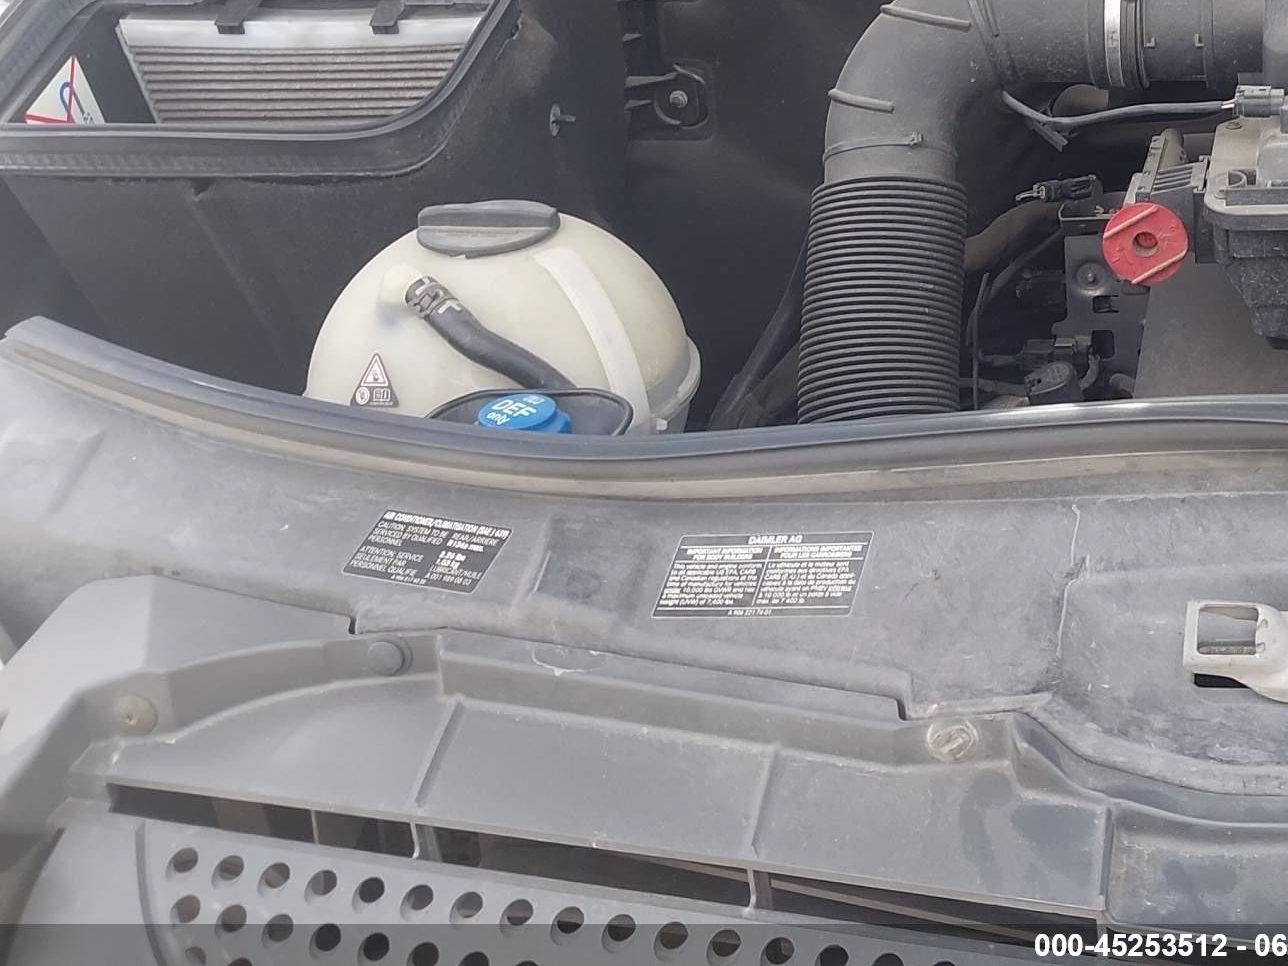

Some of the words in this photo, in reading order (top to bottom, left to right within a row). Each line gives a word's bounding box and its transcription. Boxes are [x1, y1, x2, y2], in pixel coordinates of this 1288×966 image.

[491, 399, 536, 417] DEF
[486, 412, 510, 425] only
[406, 525, 431, 534] SYSTEM
[366, 535, 403, 545] PERSONNEL
[371, 528, 403, 537] SERVICED
[410, 534, 443, 544] QUALIFIED
[747, 535, 788, 544] DAIMLER
[787, 535, 802, 543] AG
[395, 552, 423, 561] SERVICE
